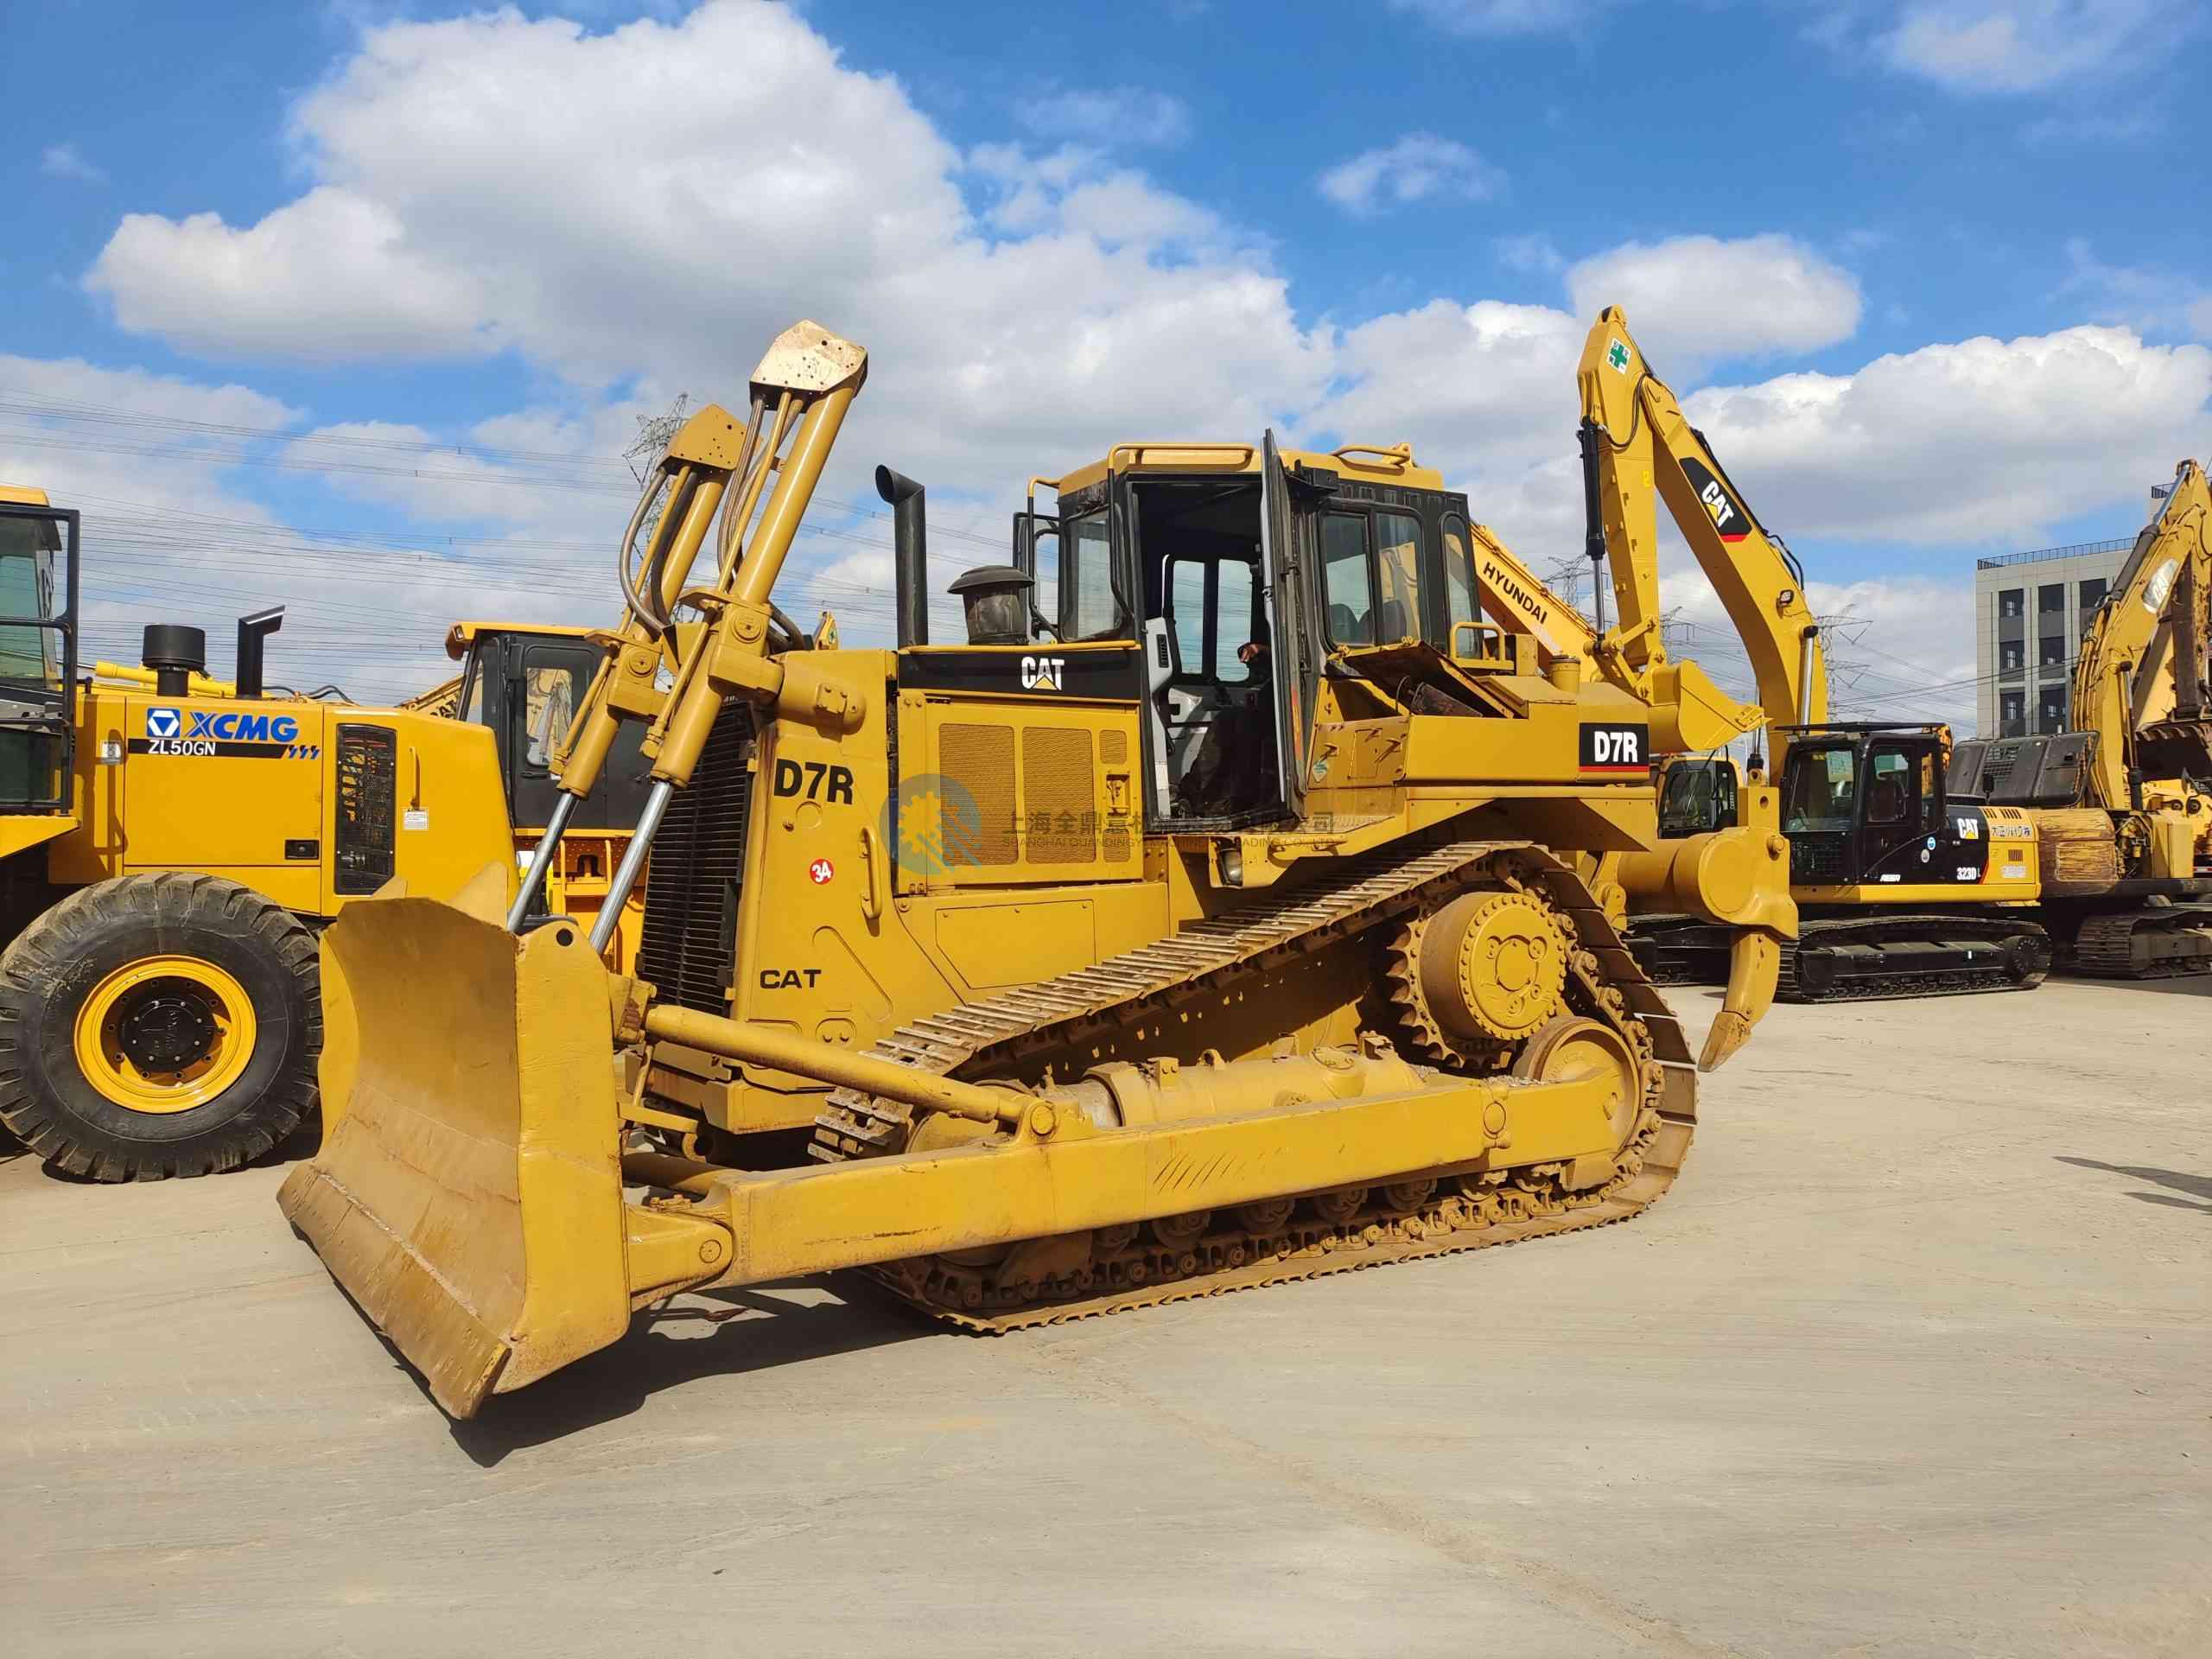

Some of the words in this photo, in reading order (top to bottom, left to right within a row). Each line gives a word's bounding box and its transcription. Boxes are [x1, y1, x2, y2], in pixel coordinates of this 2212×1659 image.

[1702, 480, 1734, 528] CAT
[1483, 562, 1548, 624] HYUNDAI
[1021, 657, 1065, 690] CAT
[186, 712, 298, 742] XCMG
[148, 740, 215, 756] ZL50GN
[1594, 731, 1638, 762] D7R
[773, 759, 854, 804] D7R
[1957, 818, 1979, 840] CAT
[760, 969, 822, 989] CAT
